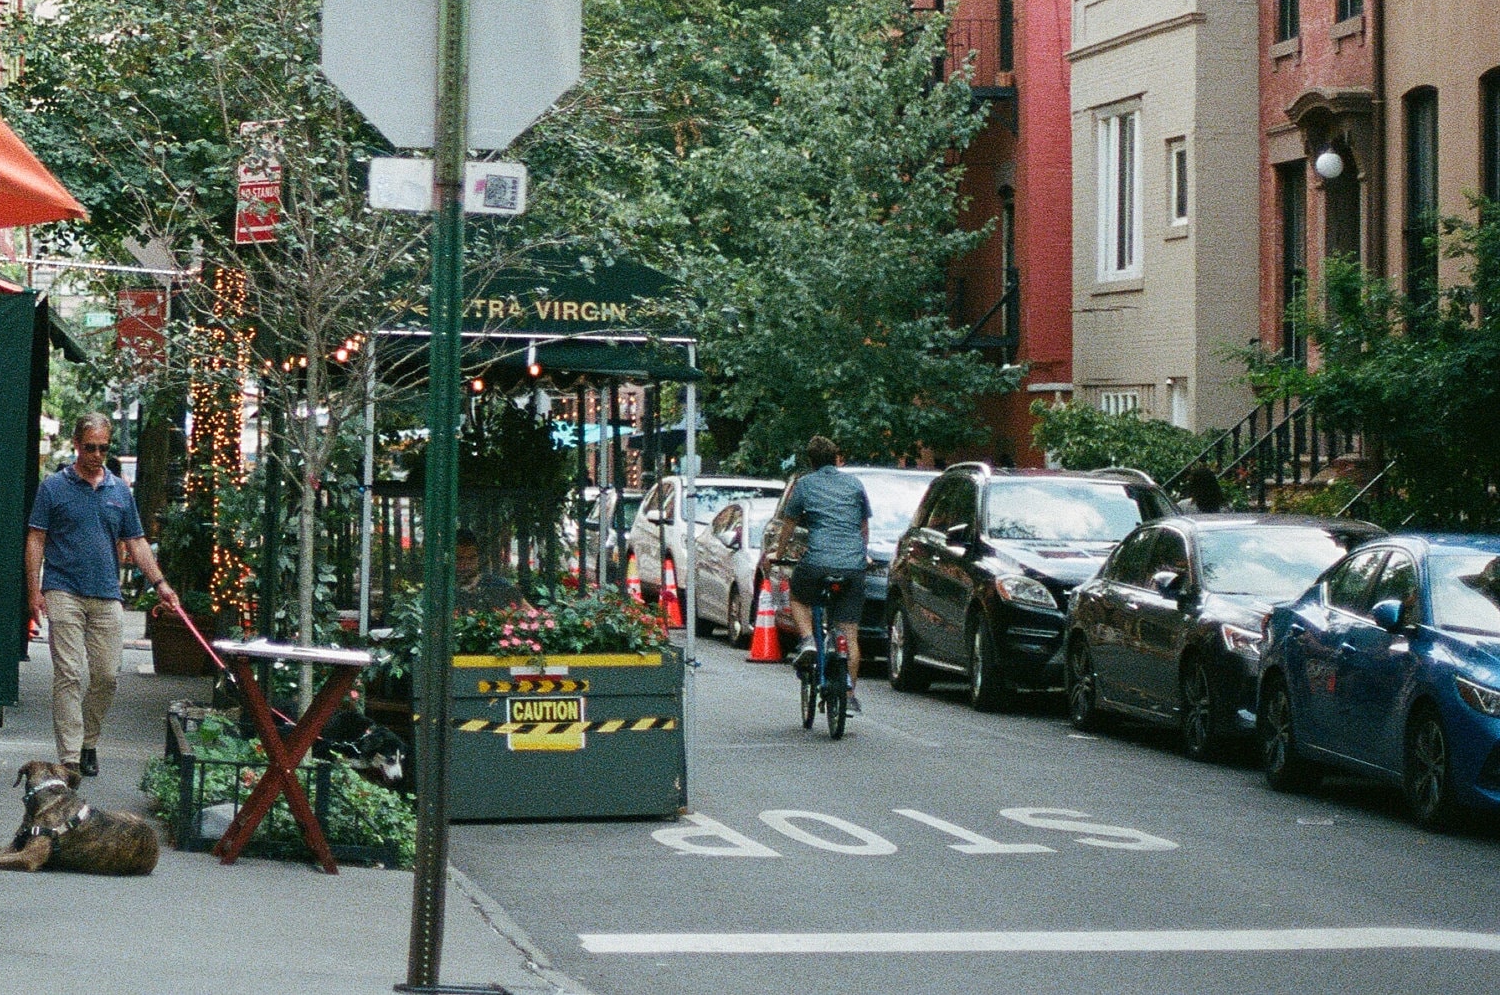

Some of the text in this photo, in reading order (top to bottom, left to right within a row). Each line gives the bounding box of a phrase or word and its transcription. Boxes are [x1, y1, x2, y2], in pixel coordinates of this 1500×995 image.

[535, 301, 627, 322] VIRGIN
[513, 701, 579, 721] CAUTION
[651, 807, 1181, 858] STOP
